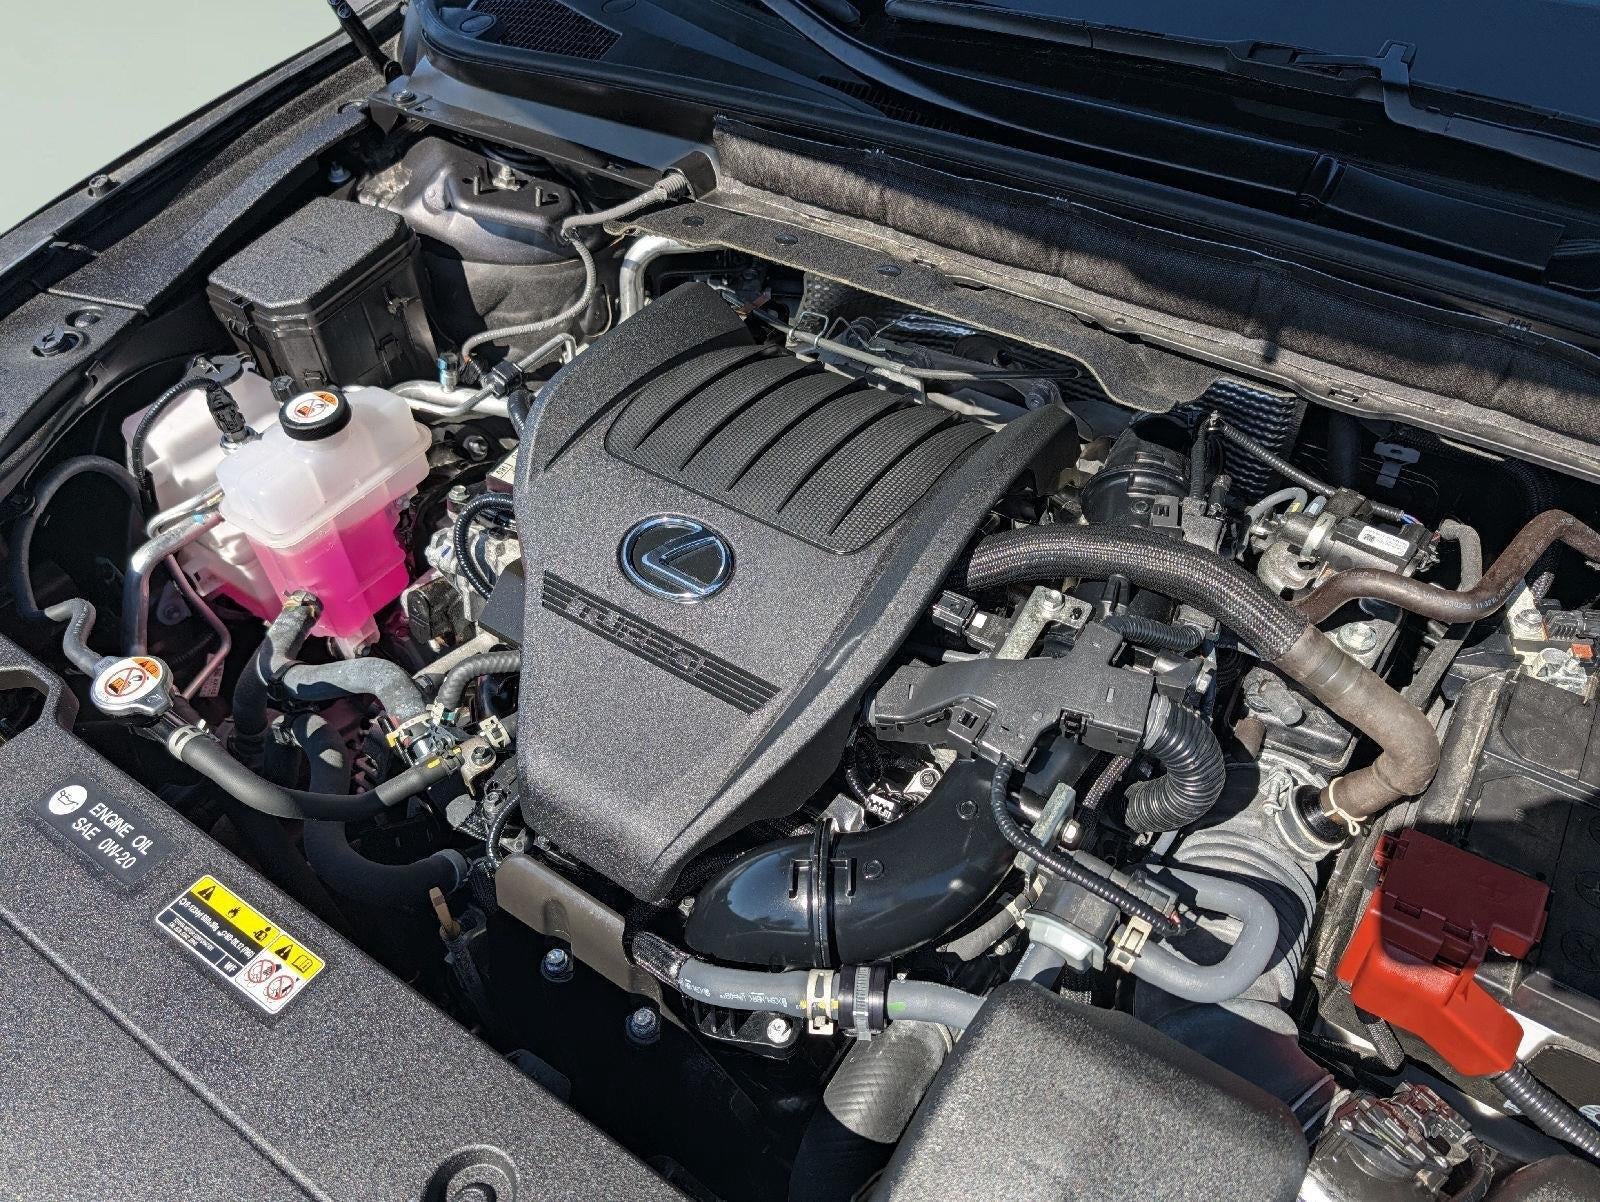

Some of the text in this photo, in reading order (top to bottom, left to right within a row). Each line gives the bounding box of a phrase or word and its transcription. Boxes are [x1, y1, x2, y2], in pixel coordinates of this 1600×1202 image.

[72, 817, 137, 869] SAE 0W-20
[89, 802, 154, 856] ENGINE OIL
[223, 961, 238, 973] WF
